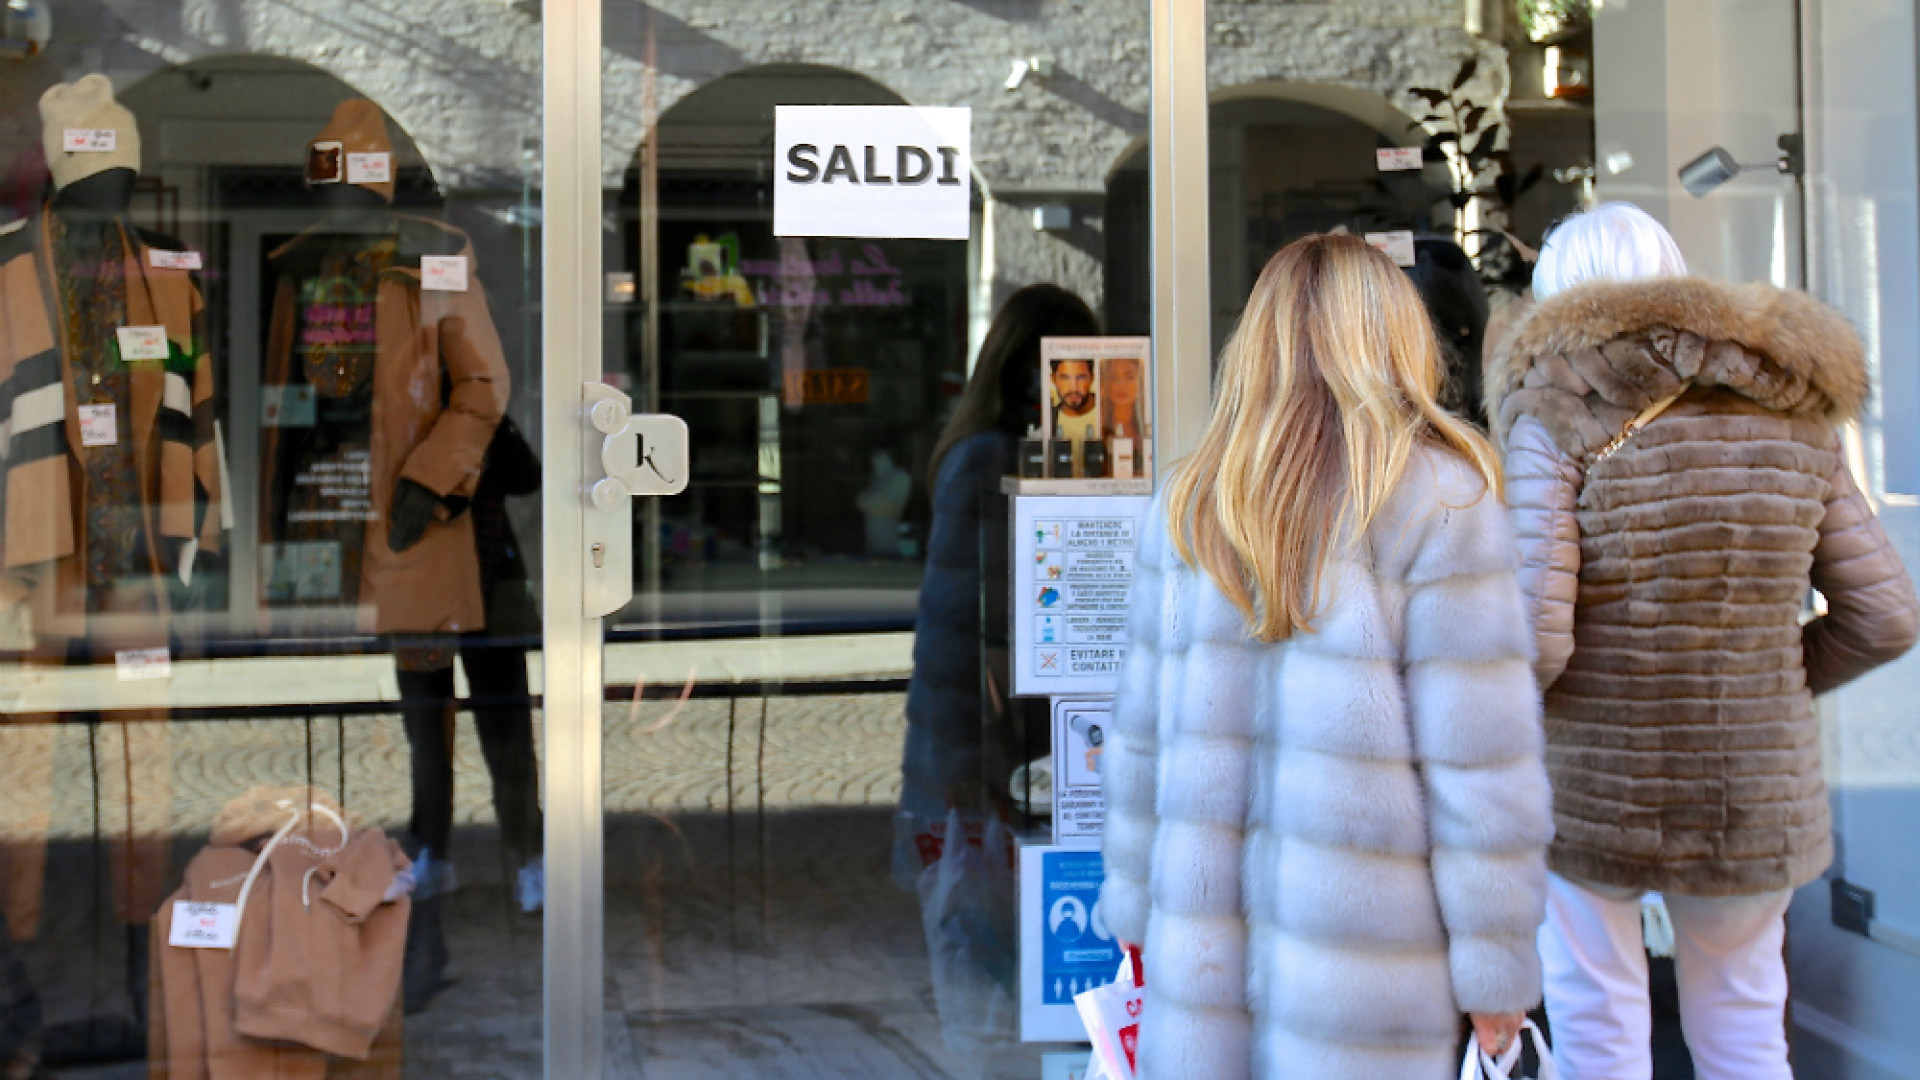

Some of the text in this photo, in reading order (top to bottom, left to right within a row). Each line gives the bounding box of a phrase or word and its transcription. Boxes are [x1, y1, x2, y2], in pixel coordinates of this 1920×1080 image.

[786, 143, 961, 186] SALDI
[1071, 649, 1115, 660] EVITARE
[1072, 661, 1123, 672] CONTATT
